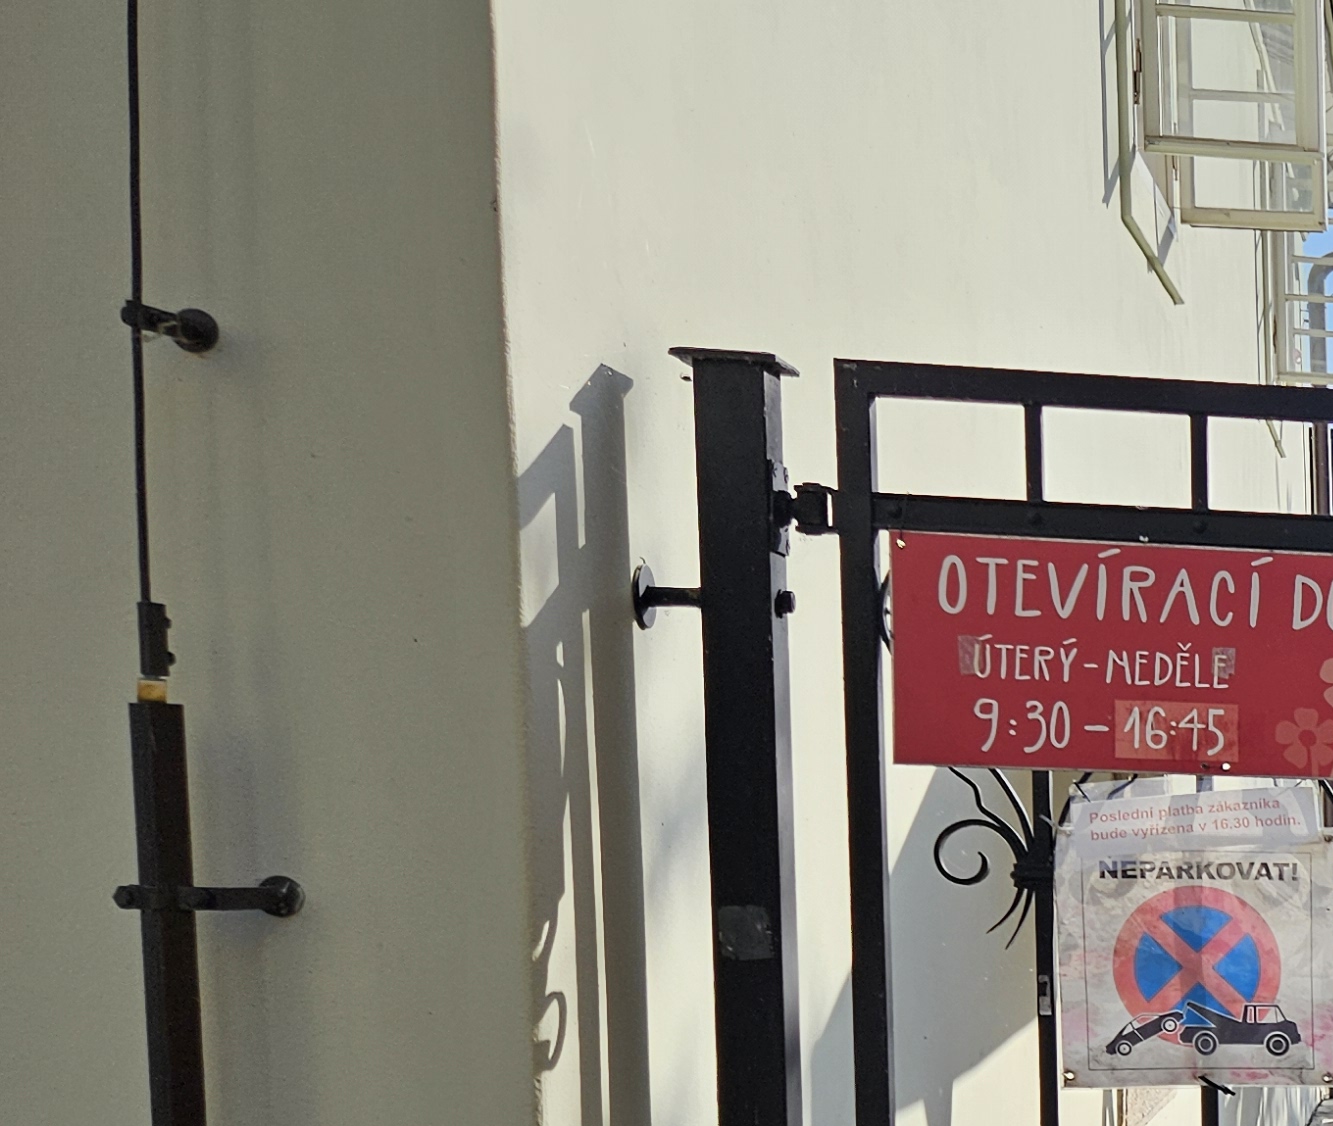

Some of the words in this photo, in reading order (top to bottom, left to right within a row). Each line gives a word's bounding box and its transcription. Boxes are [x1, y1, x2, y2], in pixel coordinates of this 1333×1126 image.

[938, 548, 1274, 629] OTEVÍRACÍ
[973, 697, 1071, 752] 9:30
[1123, 705, 1225, 757] 16:45
[1089, 806, 1153, 824] Poslední
[1158, 803, 1204, 821] platba
[1208, 798, 1281, 814] zákazníka
[1090, 827, 1127, 841] bude
[1131, 822, 1194, 839] vyřízena
[1198, 823, 1207, 832] v
[1211, 815, 1251, 831] 16.30
[1255, 814, 1301, 828] hodin.
[1098, 860, 1299, 881] NEPARKOVAT!
